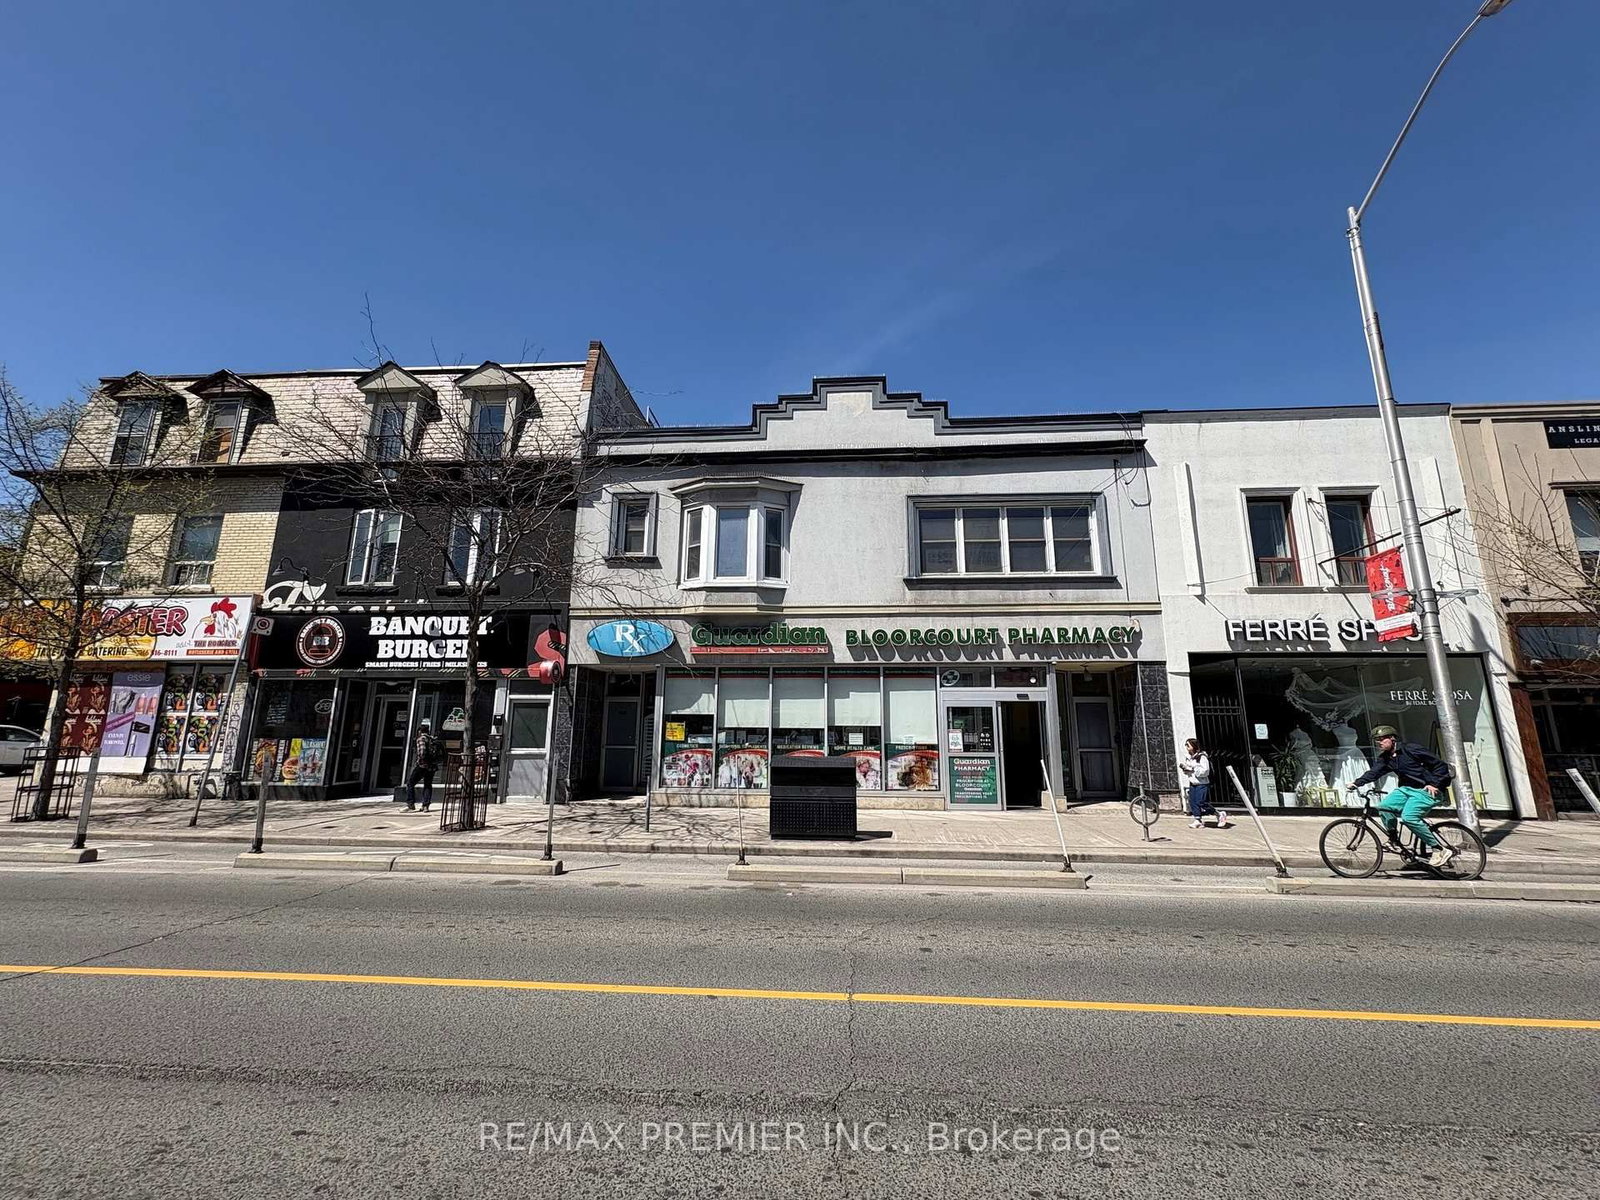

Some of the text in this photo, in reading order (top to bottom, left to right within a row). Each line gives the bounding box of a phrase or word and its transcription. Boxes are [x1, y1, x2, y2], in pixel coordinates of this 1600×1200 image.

[691, 622, 828, 646] Guardian
[845, 625, 1136, 647] BLOORCOURT PHARMACY
[1227, 613, 1329, 642] FERRÉ
[87, 646, 127, 657] CATERING
[1390, 688, 1428, 701] FERRÉ
